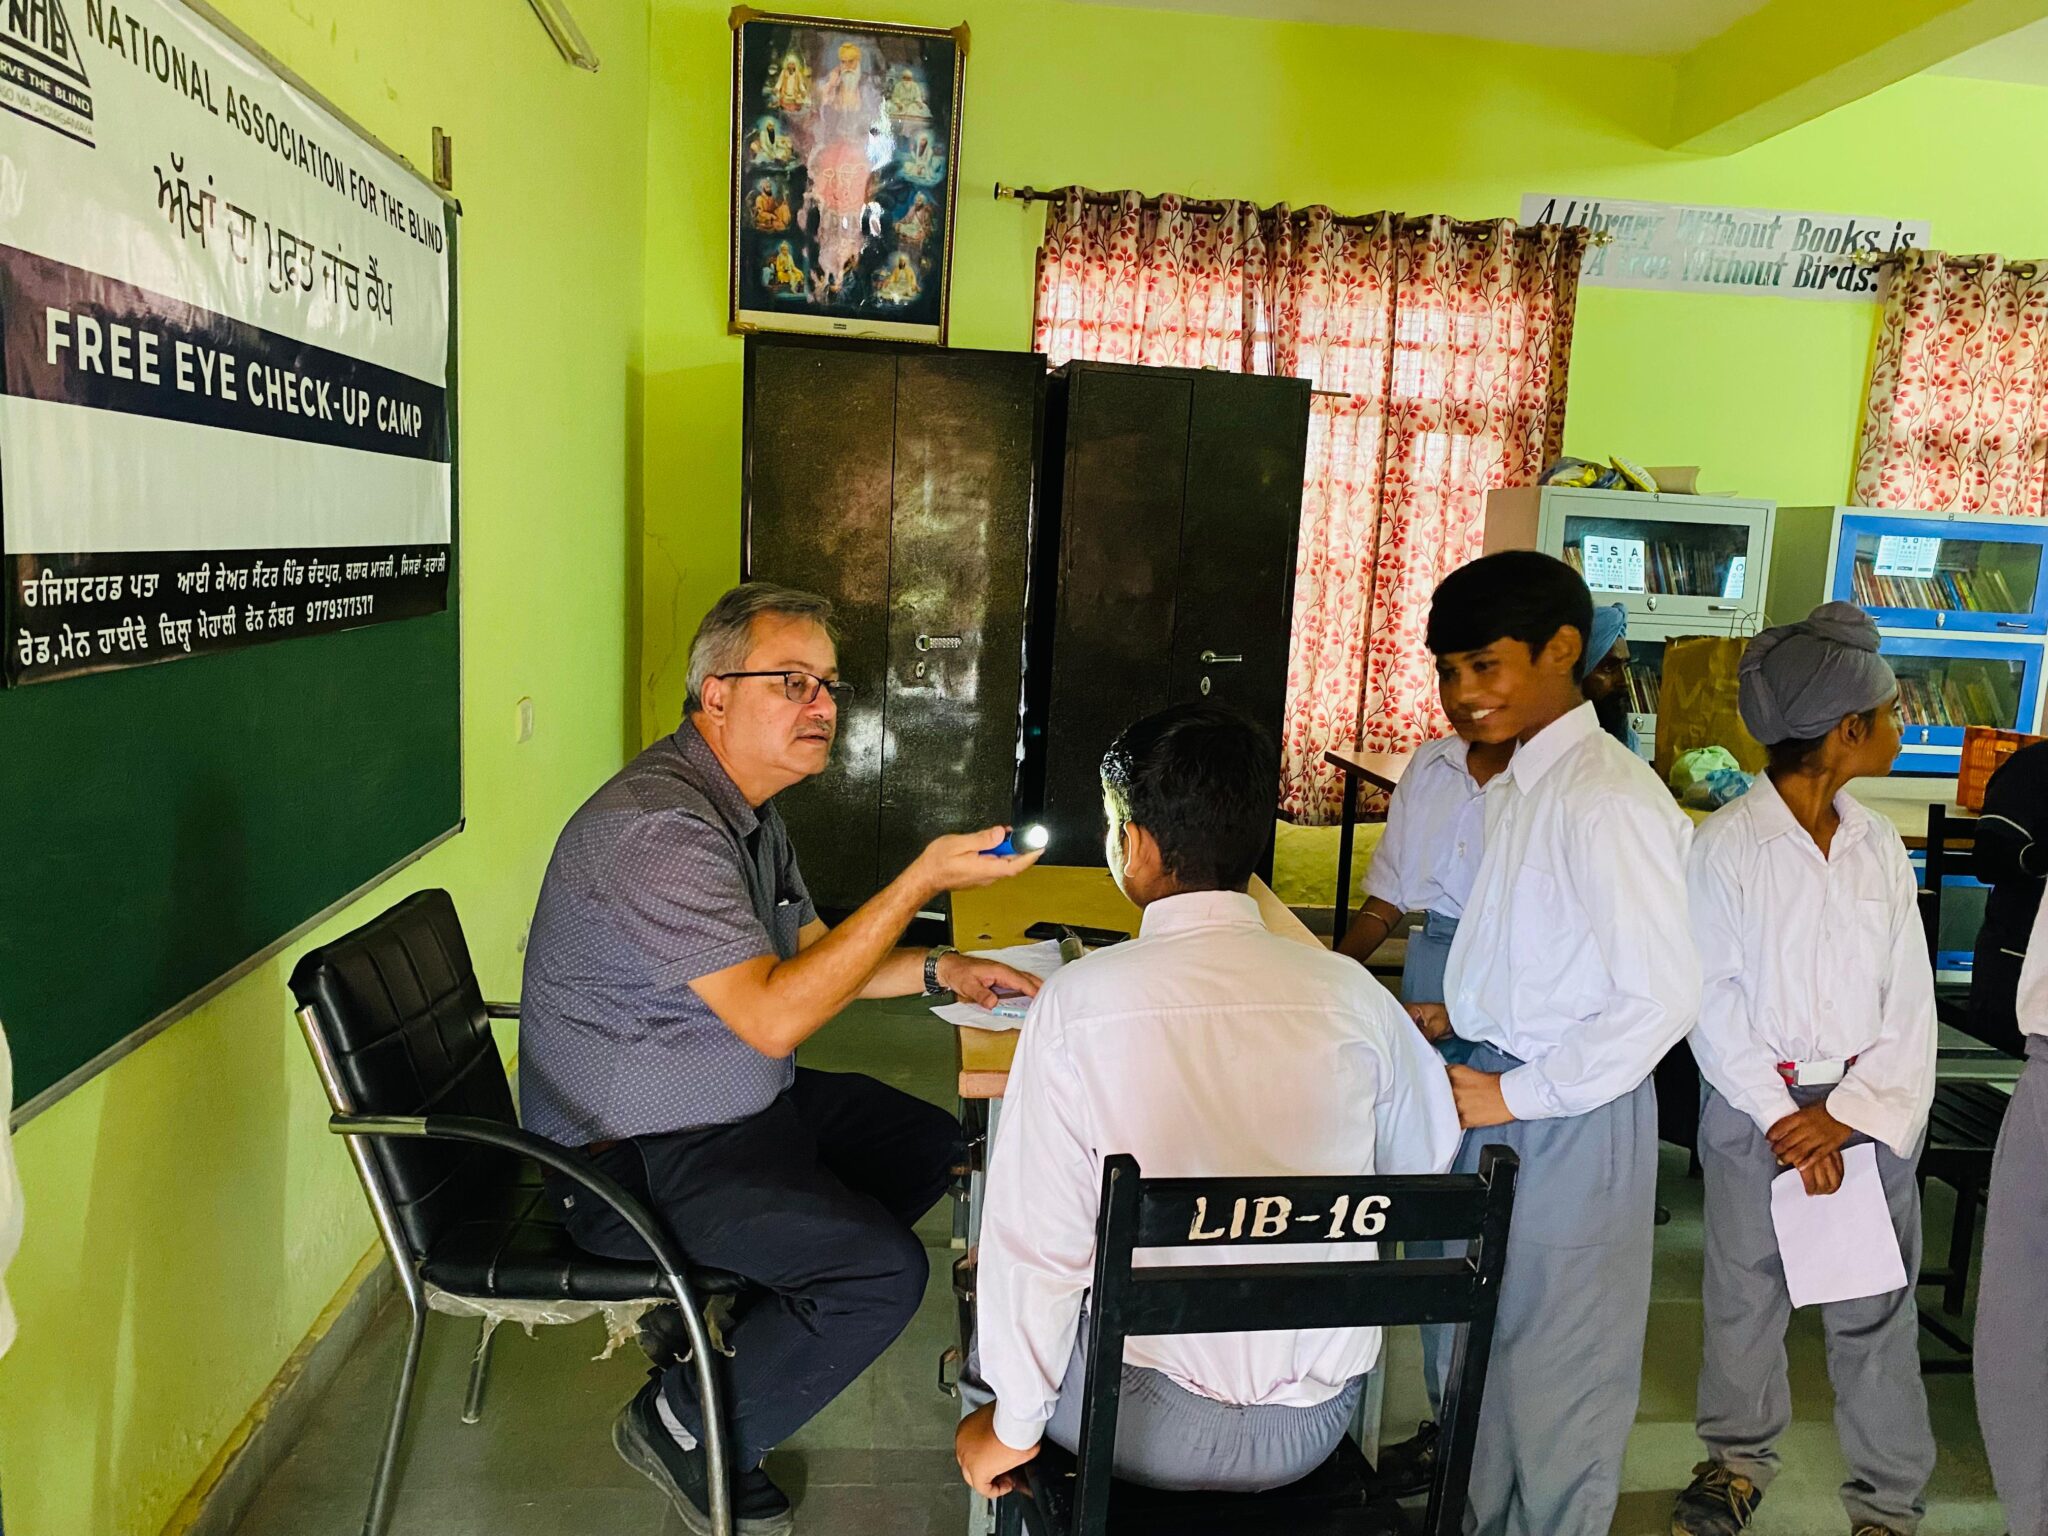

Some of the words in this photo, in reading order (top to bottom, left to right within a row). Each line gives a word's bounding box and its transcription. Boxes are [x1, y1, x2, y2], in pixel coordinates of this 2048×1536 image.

[28, 72, 52, 95] THE
[55, 86, 91, 112] BLIND
[86, 0, 218, 115] NATIONAL
[226, 85, 345, 197] ASSOCIATION
[350, 169, 376, 216] FOR
[380, 189, 405, 232] THE
[408, 208, 443, 254] BLIND
[153, 151, 217, 249] ਅੱਖਾਂ
[225, 202, 257, 265] ਦਾ
[321, 243, 360, 311] ਜਾਂਚ
[365, 254, 393, 326] ਕੈਂਪ
[1534, 199, 1557, 225] A
[1562, 201, 1664, 250] Library
[1676, 208, 1782, 249] Without
[1791, 217, 1881, 254] Books
[1889, 220, 1916, 254] is
[1681, 247, 1788, 287] Without
[1792, 253, 1879, 292] Birds.
[46, 307, 161, 386] FREE
[175, 340, 238, 401] EYE
[247, 361, 370, 428] CHECK-UP
[376, 400, 423, 438] CAMP
[22, 568, 123, 608] ਰਜਿਸਟਰਡ
[129, 573, 160, 599] ਪਤਾ
[177, 562, 211, 595] ਆਈ
[215, 562, 249, 592] ਕੇਅਰ
[283, 558, 305, 587] ਪਿੰਡ
[345, 562, 369, 581] ਬਲਾਕ
[97, 615, 149, 654] ਹਾਈਵੇ
[197, 604, 236, 639] ਮੋਹਾਲੀ
[268, 600, 295, 629] ਨੰਬਰ
[306, 594, 374, 623] 9779377377
[1188, 1194, 1392, 1241] LIB-16
